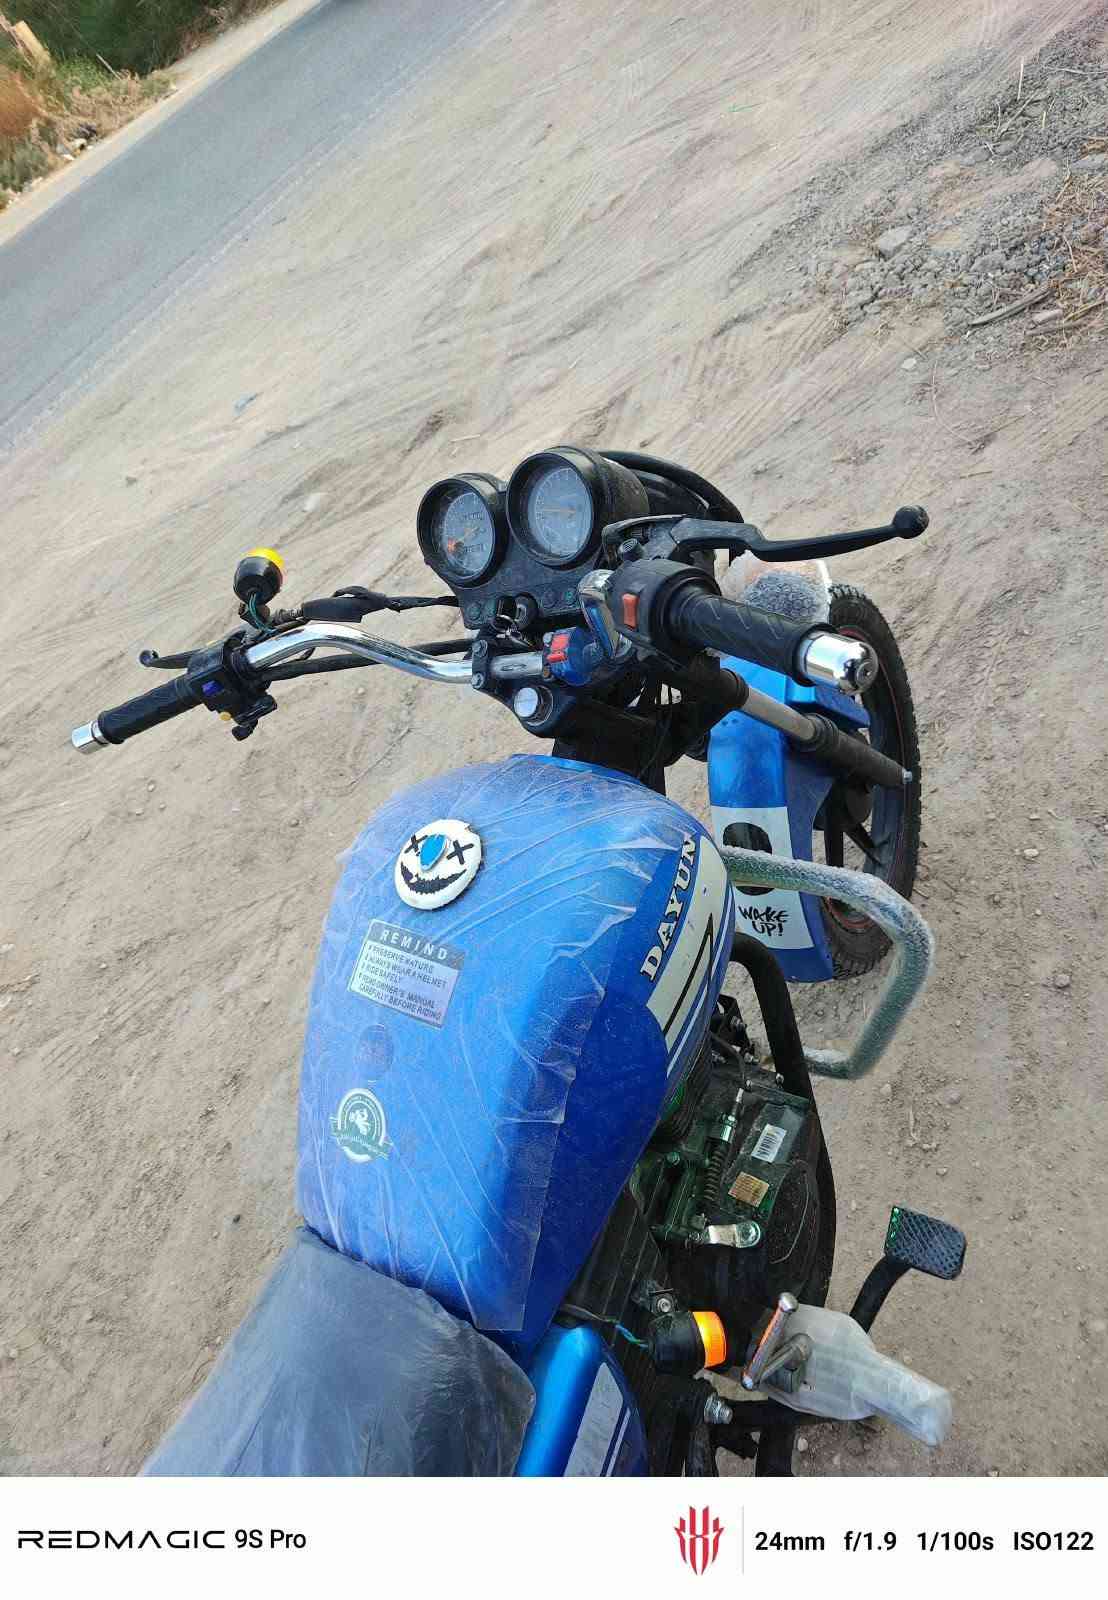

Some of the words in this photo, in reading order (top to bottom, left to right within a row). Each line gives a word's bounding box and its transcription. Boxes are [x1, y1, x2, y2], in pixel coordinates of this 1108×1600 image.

[640, 832, 696, 982] DAYUN
[738, 905, 791, 923] WAKE
[751, 921, 785, 937] UP!
[379, 929, 449, 961] REMIND
[372, 945, 402, 963] SERVE
[402, 956, 435, 974] ATUR
[376, 980, 405, 998] WNER
